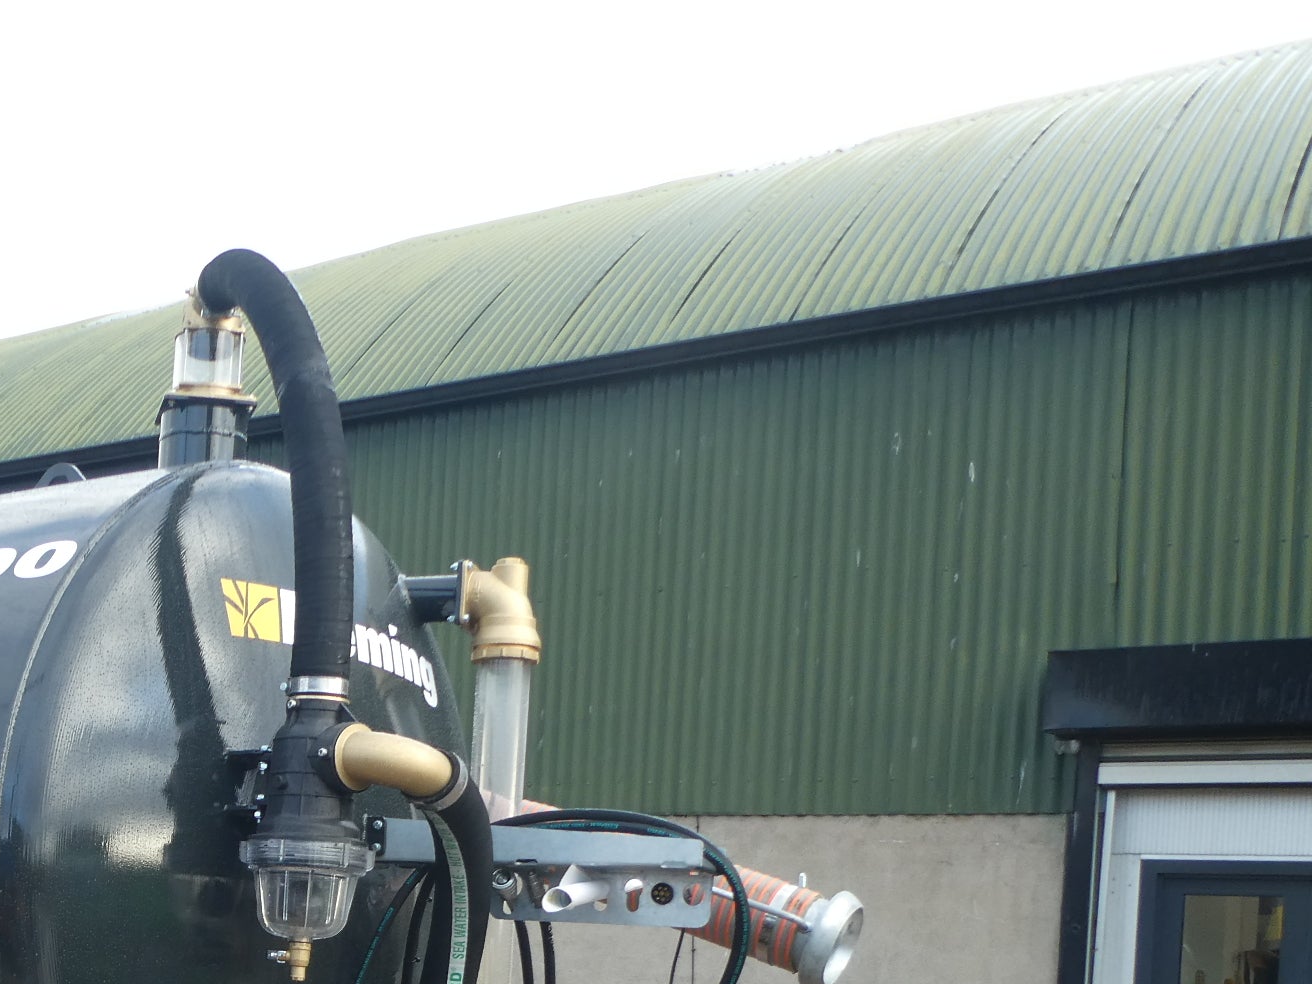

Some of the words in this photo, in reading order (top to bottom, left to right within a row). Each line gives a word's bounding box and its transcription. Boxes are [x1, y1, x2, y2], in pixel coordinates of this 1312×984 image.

[453, 874, 466, 905] INTAKE
[454, 907, 466, 940] WATER
[452, 941, 465, 959] SEA
